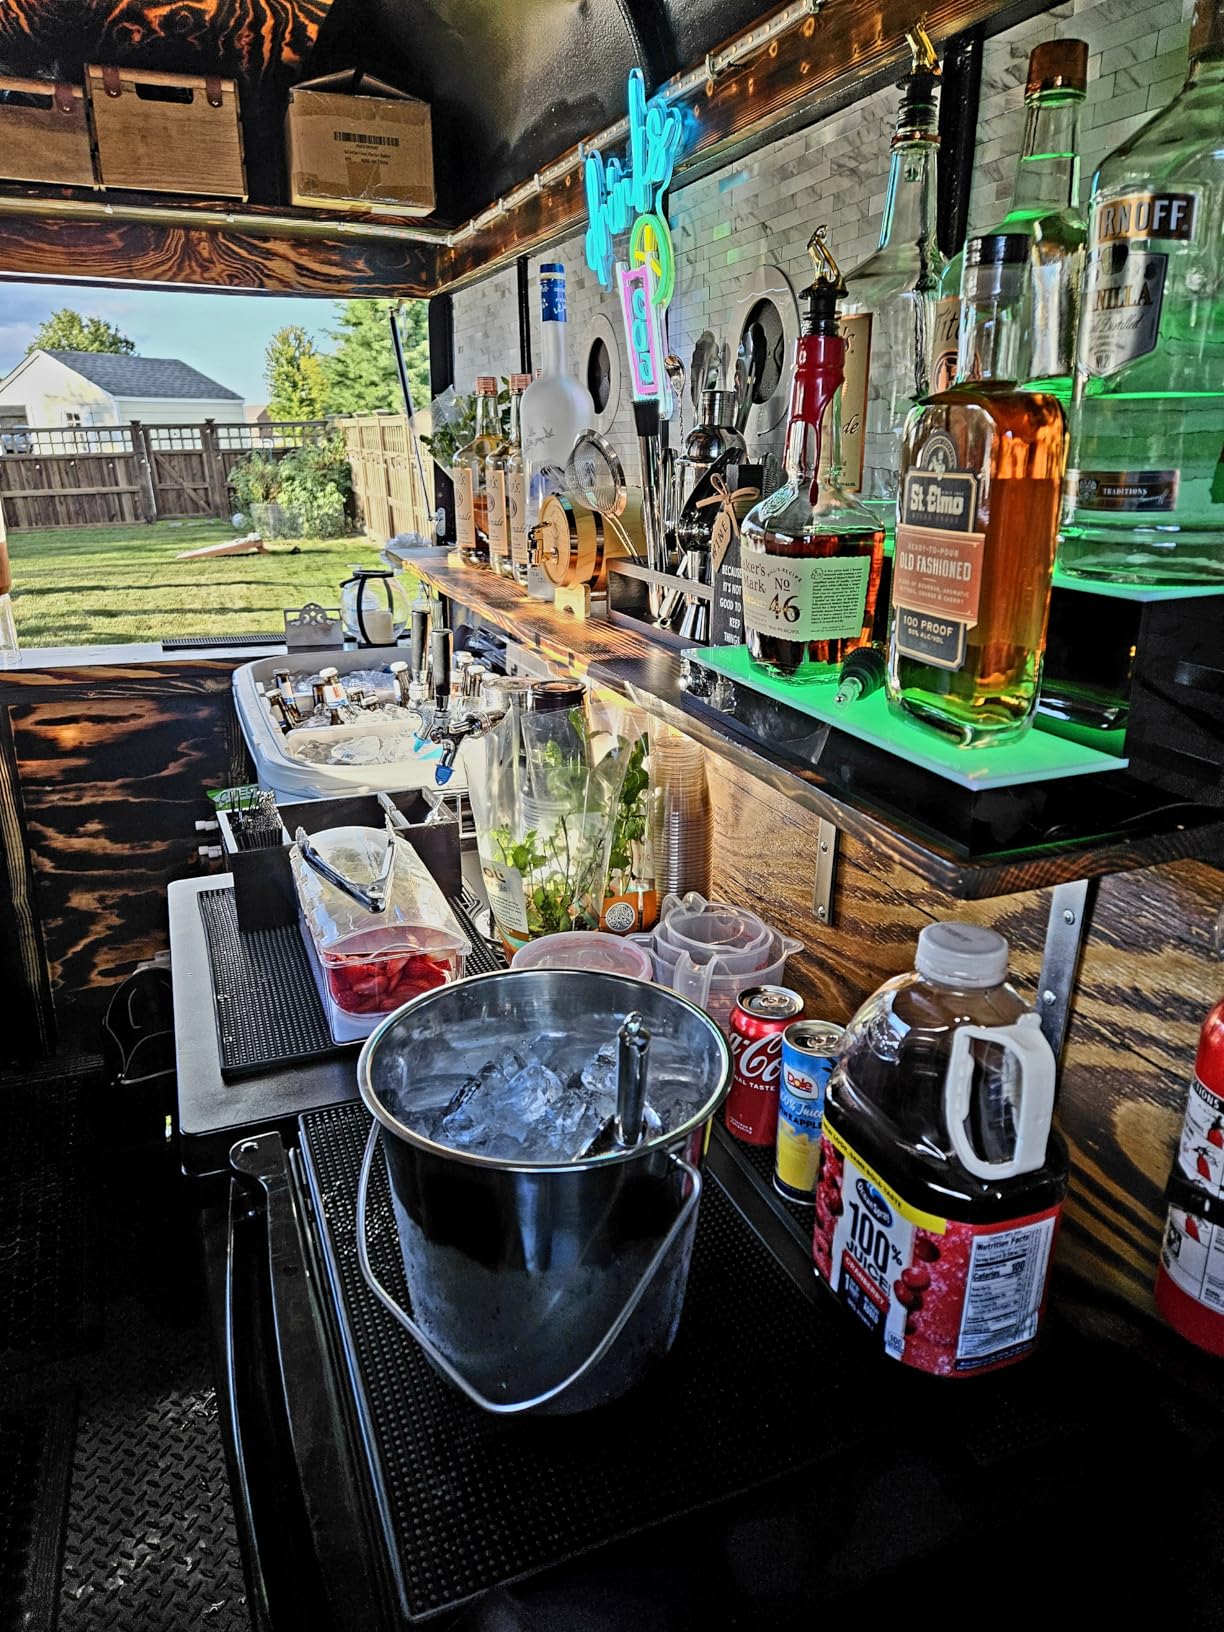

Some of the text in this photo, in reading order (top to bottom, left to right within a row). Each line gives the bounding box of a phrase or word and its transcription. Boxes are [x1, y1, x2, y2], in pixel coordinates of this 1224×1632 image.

[926, 484, 965, 516] Elmo
[1103, 487, 1148, 496] TRADITIONS
[899, 551, 972, 581] OLD FASHIONED
[720, 597, 733, 611] GOOD
[769, 593, 800, 623] 46
[729, 617, 741, 629] KEEP
[903, 615, 954, 637] 100 PROOF
[749, 1081, 776, 1092] TASTE
[787, 1071, 813, 1091] Dole
[856, 1181, 874, 1208] Ocean
[849, 1200, 903, 1275] 100%
[976, 1240, 1009, 1251] Nutrition
[1010, 1234, 1030, 1245] Facts
[844, 1256, 885, 1305] CRANBERRY
[973, 1270, 1001, 1280] Calories
